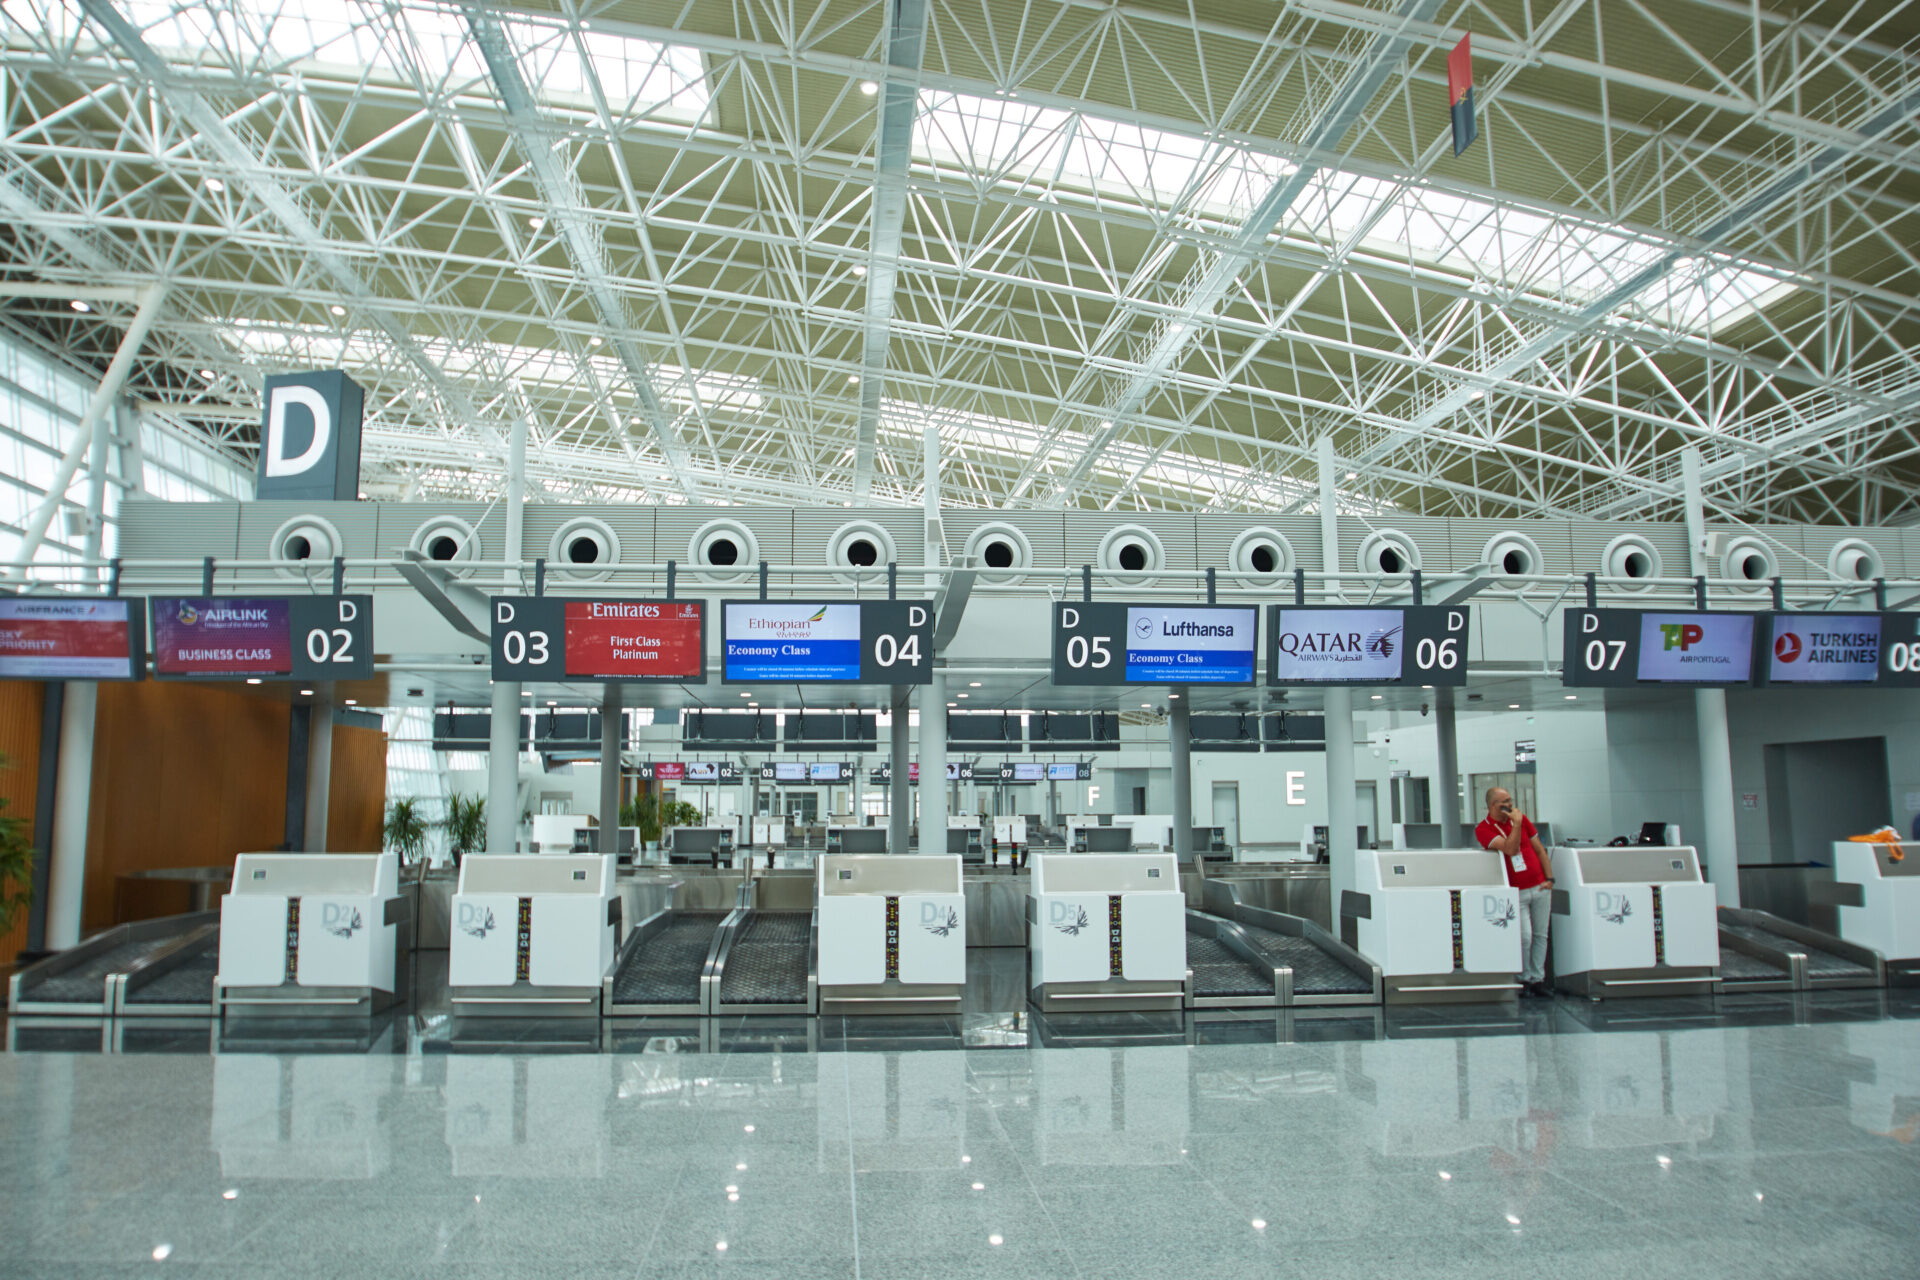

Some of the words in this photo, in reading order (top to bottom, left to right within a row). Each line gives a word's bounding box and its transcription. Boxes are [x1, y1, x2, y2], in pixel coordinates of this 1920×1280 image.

[266, 385, 331, 478] D
[205, 609, 268, 621] AIRLINK
[339, 600, 357, 622] D
[497, 602, 515, 624] D
[593, 602, 660, 618] Emirates
[909, 606, 927, 627] D
[1062, 608, 1079, 628] D
[749, 617, 811, 631] Ethiopian
[1163, 621, 1234, 637] Lufthansa
[1447, 611, 1464, 631] D
[1583, 613, 1599, 633] D
[306, 628, 354, 663] 02
[503, 630, 549, 664] 03
[610, 636, 634, 647] First
[636, 636, 661, 647] Class
[1279, 633, 1362, 657] QATAR
[1660, 623, 1704, 651] TAP
[1810, 633, 1877, 647] TURKISH
[178, 649, 233, 661] BUSINESS
[236, 649, 271, 661] CLASS
[613, 649, 658, 660] Platinum
[728, 645, 778, 657] Economy
[781, 644, 811, 656] Class
[875, 634, 922, 667] 04
[1066, 635, 1111, 669] 05
[1129, 653, 1174, 665] Economy
[1177, 653, 1203, 664] Class
[1298, 654, 1334, 662] AIRWAYS
[1416, 638, 1458, 670] 06
[1585, 640, 1627, 671] 07
[1808, 649, 1877, 663] AIRLINES
[642, 768, 653, 778] 01
[721, 768, 732, 777] 02
[762, 769, 774, 777] 03
[841, 769, 853, 777] 04
[961, 769, 973, 777] 06
[1001, 769, 1013, 777] 07
[1088, 786, 1100, 807] F
[1286, 771, 1306, 805] E
[322, 902, 350, 924] D2
[458, 903, 484, 924] D3
[920, 901, 947, 923] D4
[1050, 901, 1077, 923] D5
[1483, 895, 1505, 915] D6
